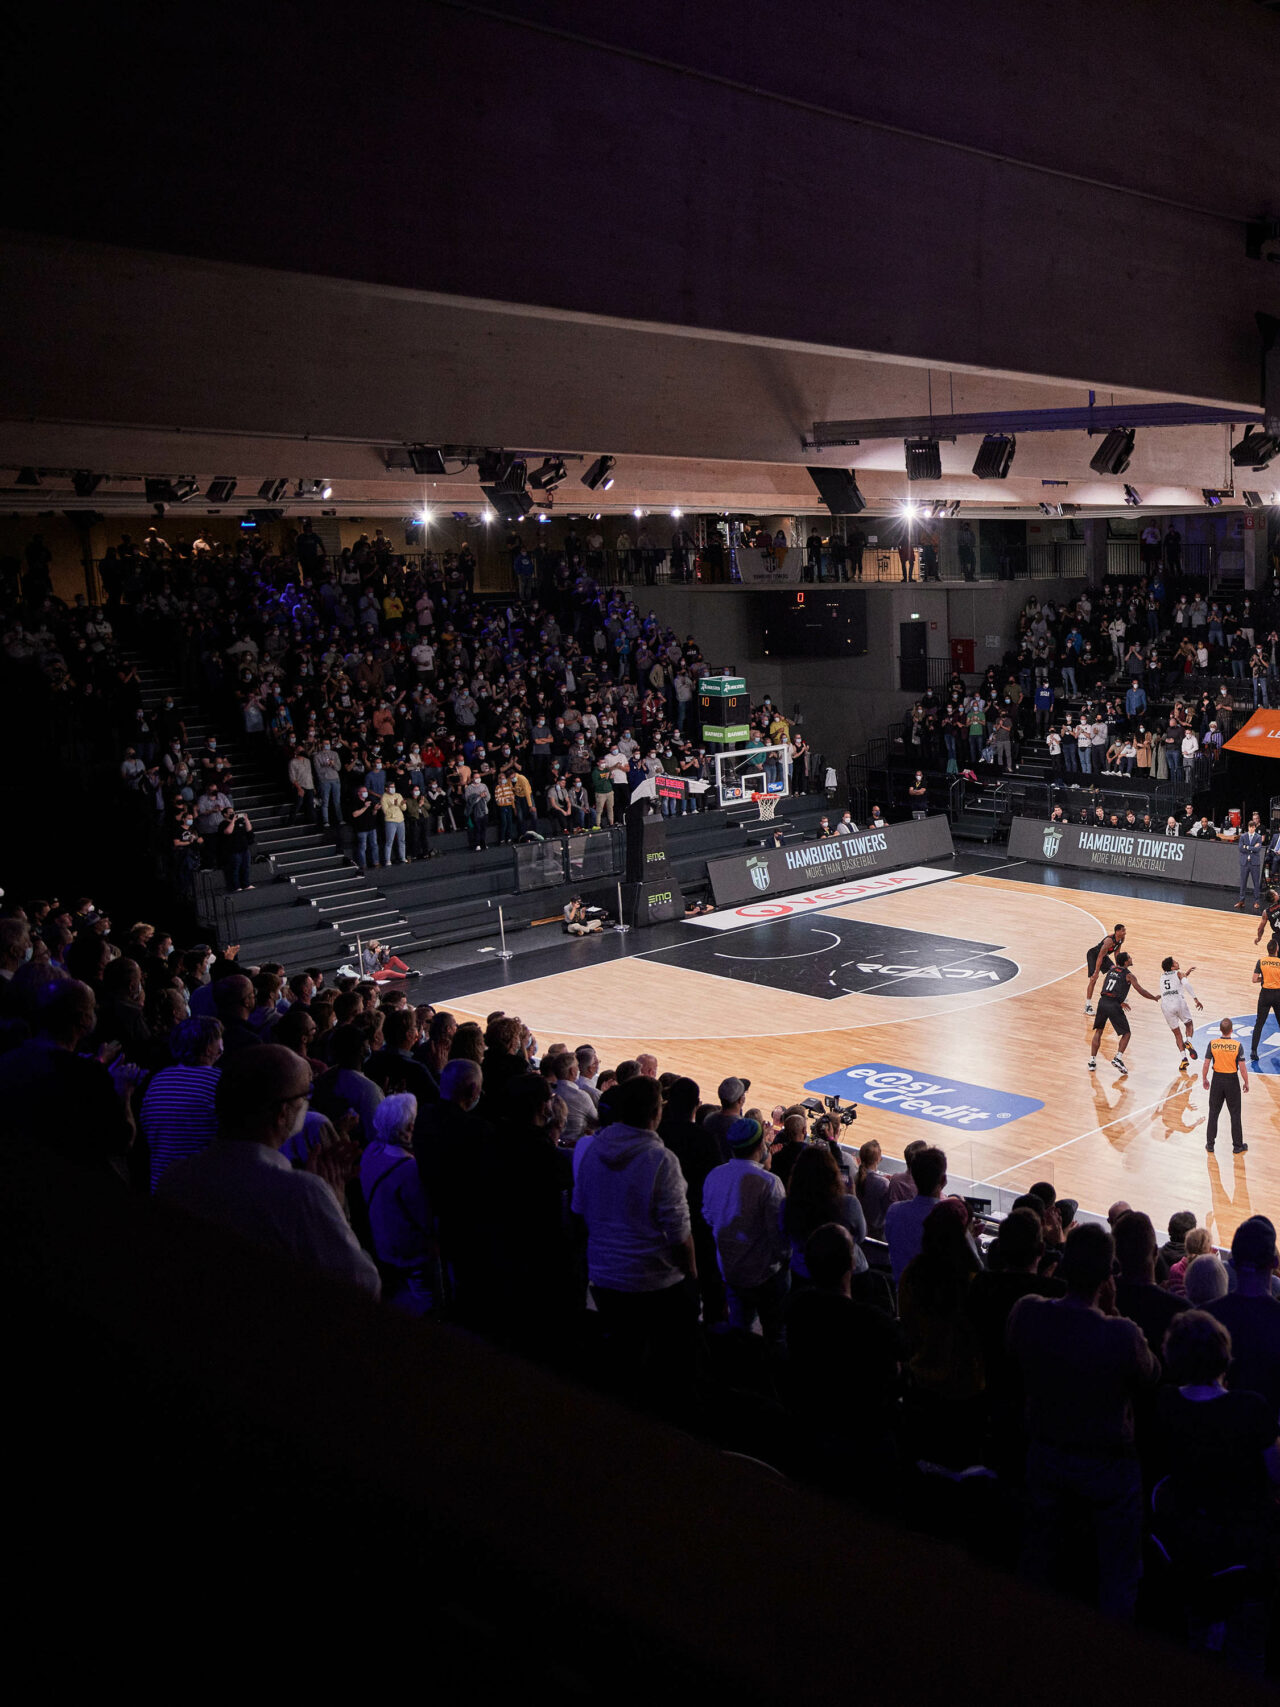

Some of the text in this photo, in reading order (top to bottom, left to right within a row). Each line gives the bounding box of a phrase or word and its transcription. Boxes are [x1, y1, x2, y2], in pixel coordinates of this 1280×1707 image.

[797, 592, 804, 602] 0
[701, 697, 710, 707] 10
[728, 697, 737, 708] 10
[785, 833, 888, 870] HAMBURG TOWERS
[1078, 831, 1185, 861] HAMBURG TOWERS
[805, 854, 878, 879] MORE THAN BASKETBALL
[1091, 852, 1166, 872] MORE THAN BASKETBALL
[787, 877, 918, 905] VEOLIA
[1164, 979, 1171, 990] 5
[1211, 1042, 1237, 1051] GYMPER
[863, 1088, 992, 1124] Credit
